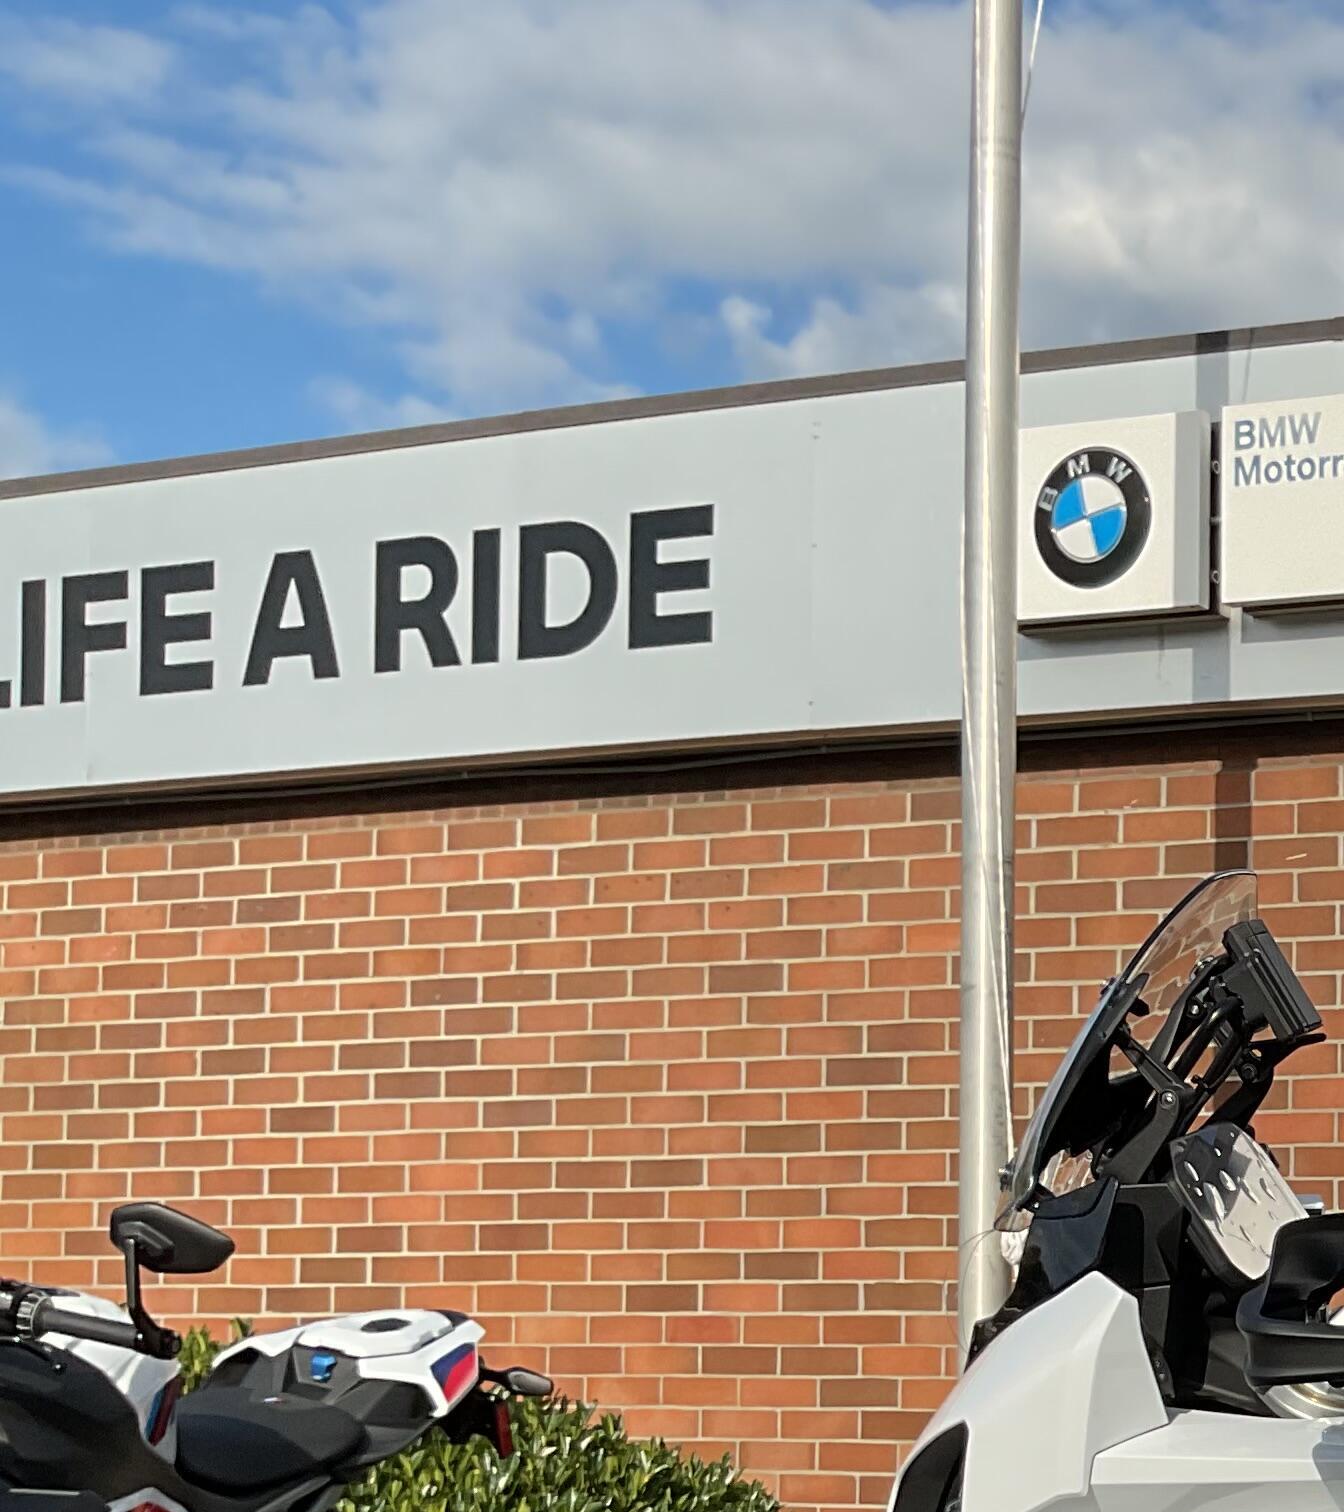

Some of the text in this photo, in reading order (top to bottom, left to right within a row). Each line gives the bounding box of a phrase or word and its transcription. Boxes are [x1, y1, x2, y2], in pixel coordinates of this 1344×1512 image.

[1233, 412, 1321, 450] BMW
[1037, 452, 1133, 512] BMW
[0, 503, 715, 708] IFE A RIDE
